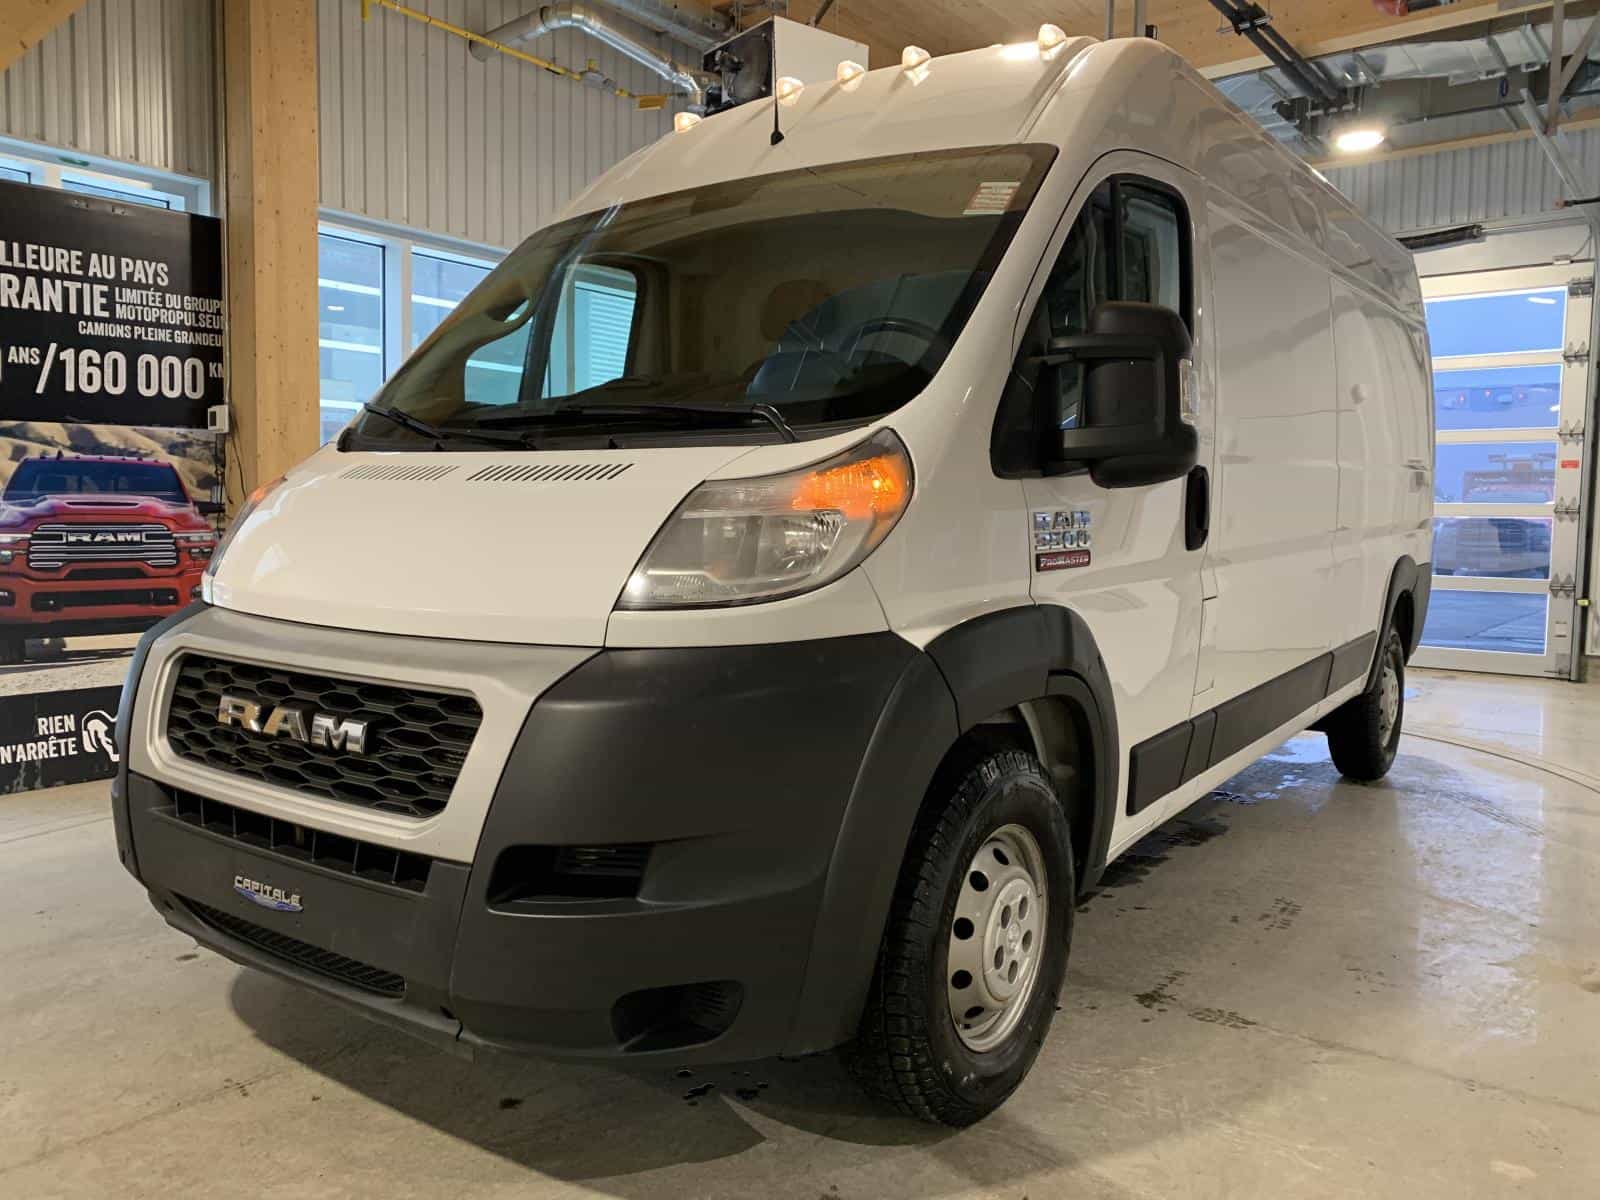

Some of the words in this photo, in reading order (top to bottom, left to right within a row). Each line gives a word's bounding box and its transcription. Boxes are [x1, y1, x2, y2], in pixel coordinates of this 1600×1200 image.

[88, 253, 115, 279] AU
[121, 257, 169, 286] PAYS
[0, 273, 110, 317] RANTIE
[115, 287, 162, 307] LIMITÉE
[165, 293, 181, 309] DU
[78, 320, 131, 339] CAMIONS
[134, 326, 172, 343] PLEINE
[174, 330, 223, 347] GRANDEU
[8, 345, 40, 365] ANS
[137, 353, 204, 400] 000
[67, 532, 141, 542] RAM
[37, 714, 76, 736] RIEN
[217, 695, 368, 754] RAM
[0, 736, 78, 764] N'ARRÊTE
[234, 875, 301, 906] CAPITALE
